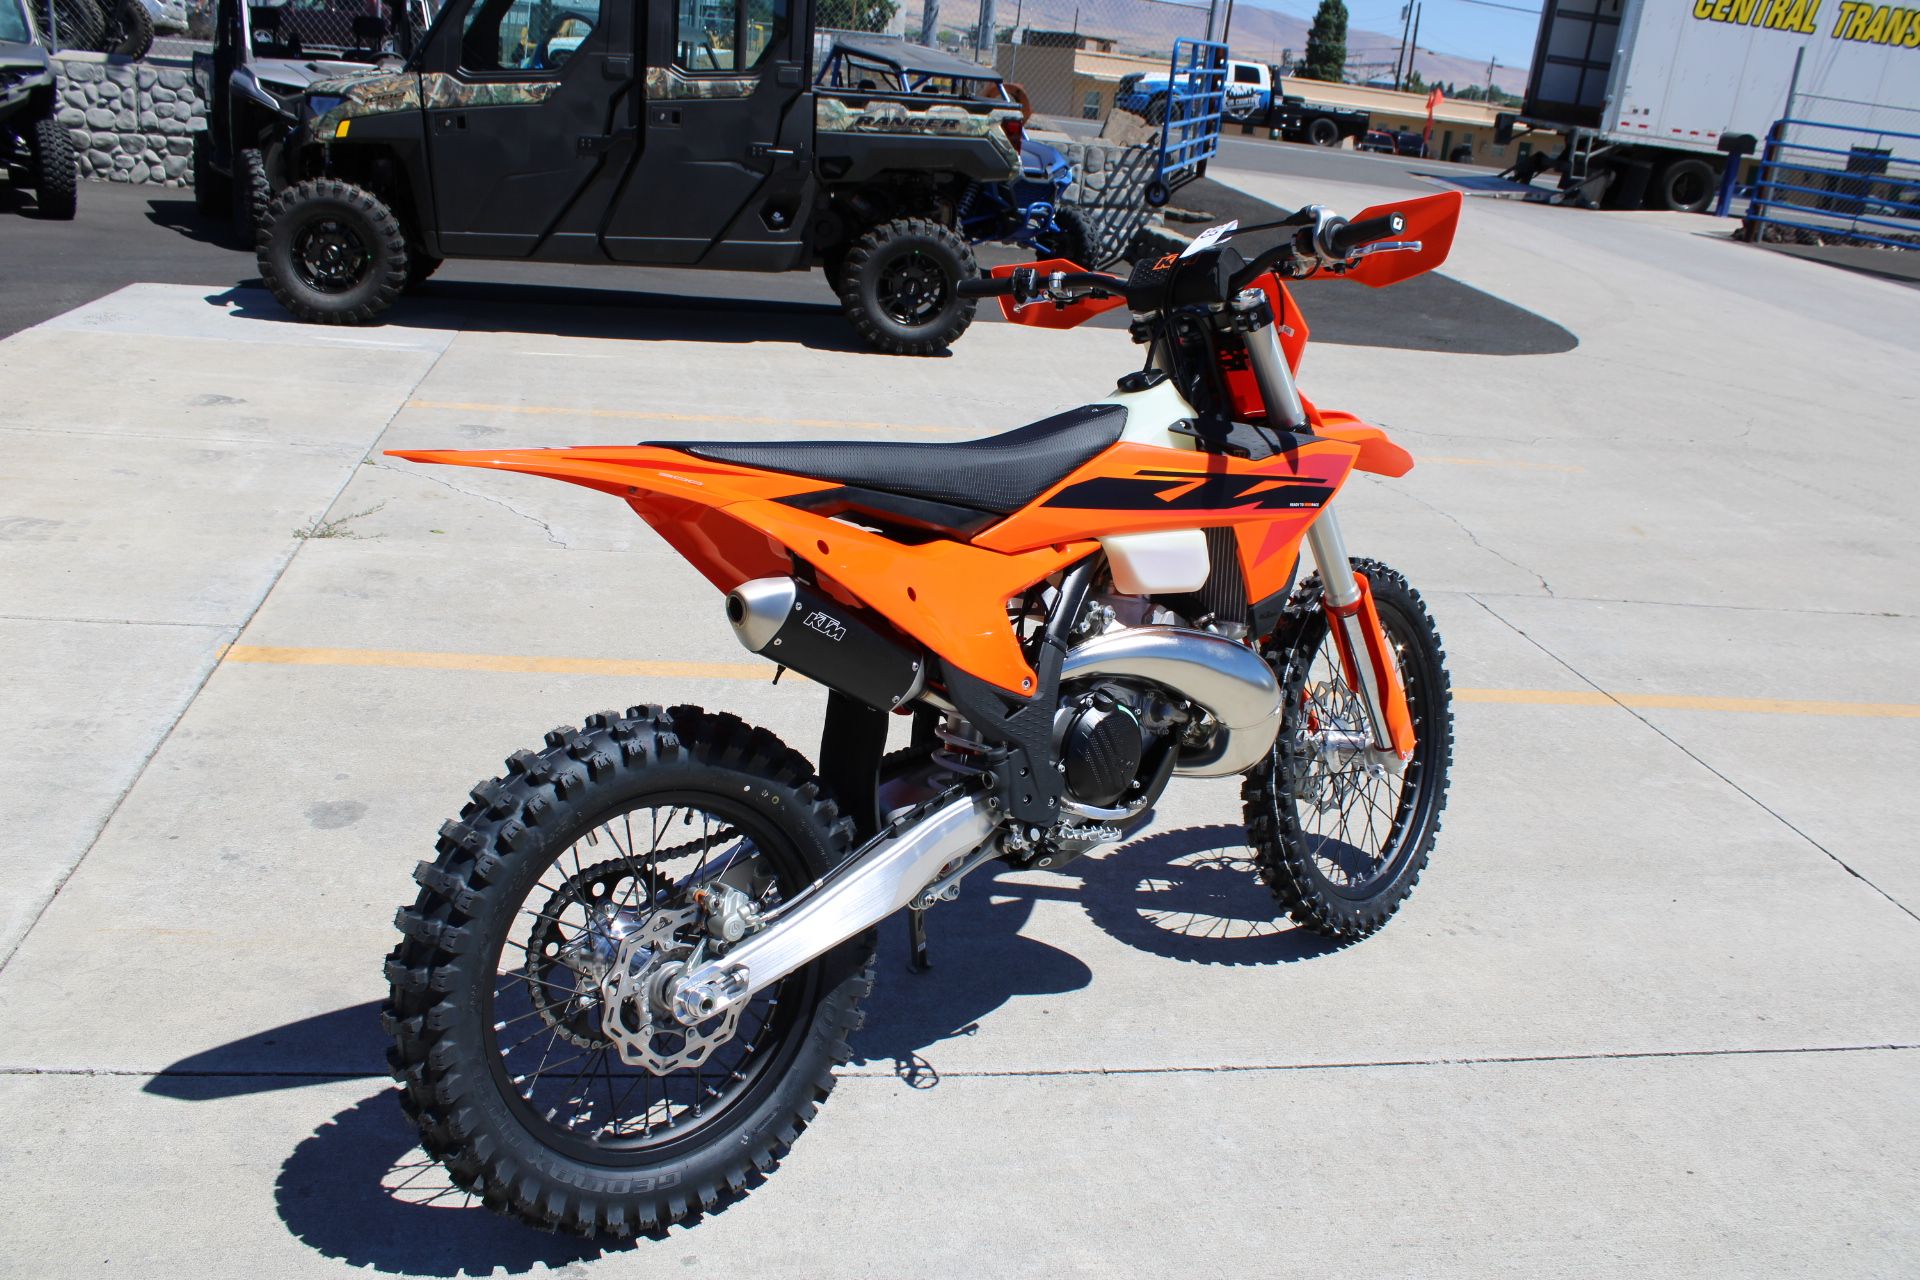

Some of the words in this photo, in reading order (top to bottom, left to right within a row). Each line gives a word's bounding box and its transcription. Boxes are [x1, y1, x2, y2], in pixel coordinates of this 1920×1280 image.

[1692, 0, 1817, 35] CENTRAL
[855, 115, 961, 130] RANGER
[803, 611, 847, 642] KTM
